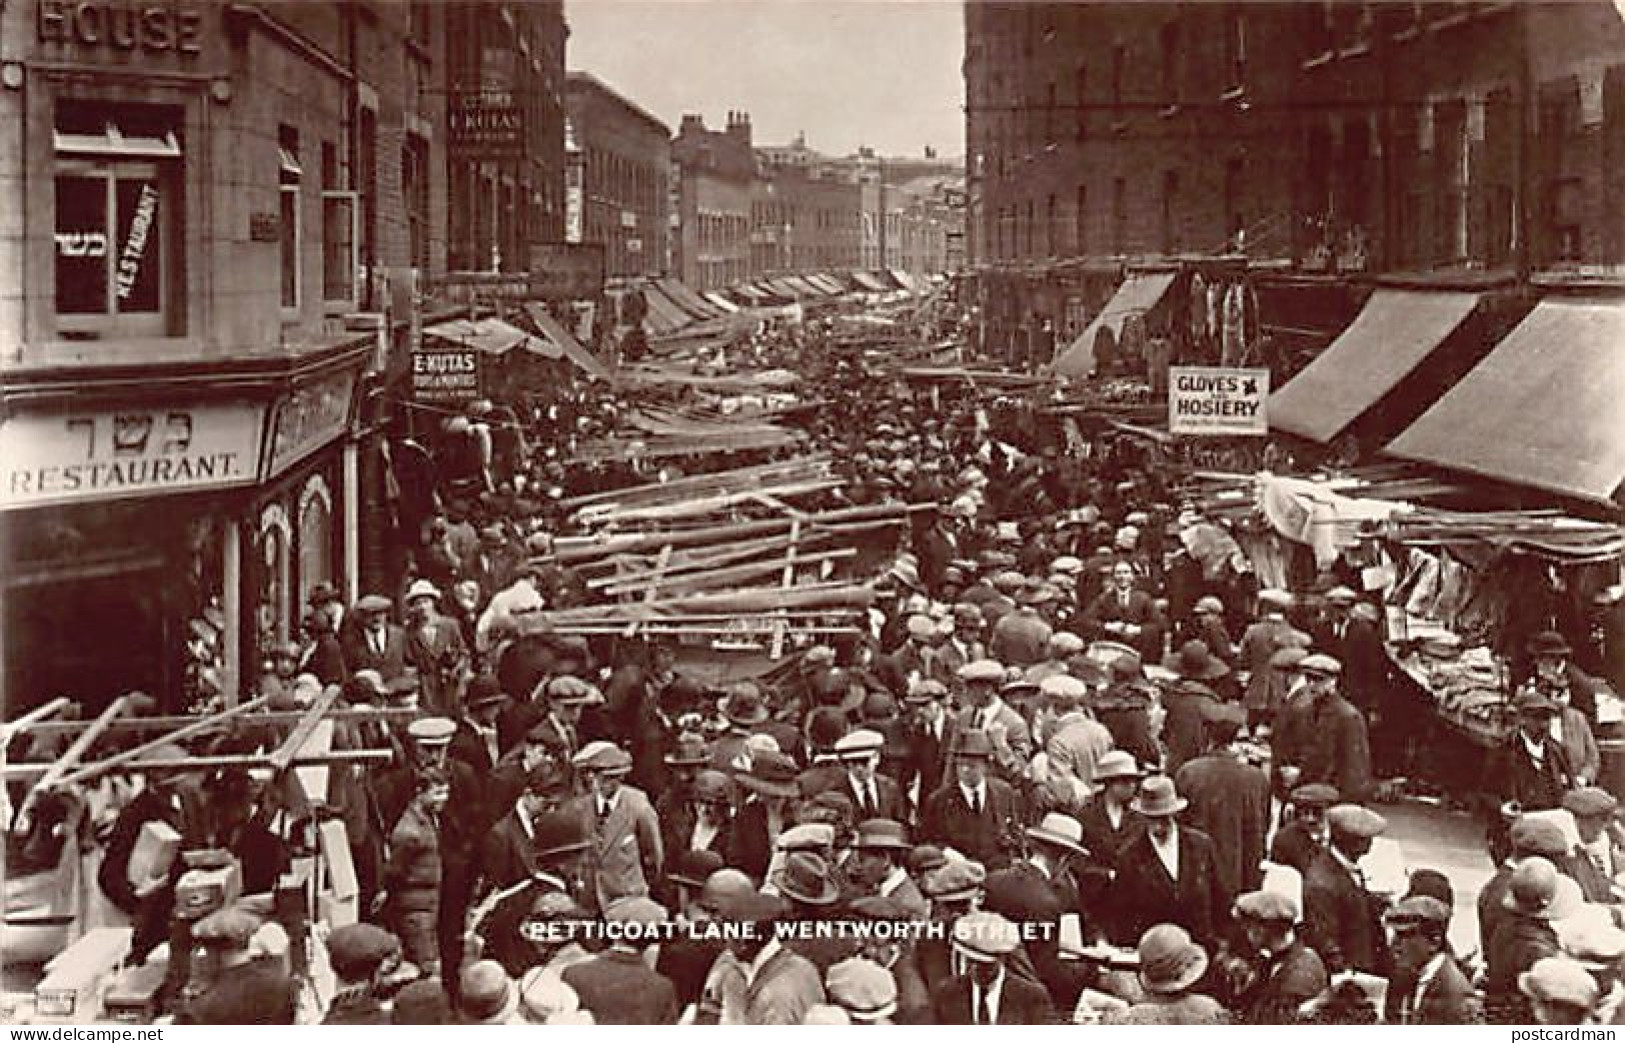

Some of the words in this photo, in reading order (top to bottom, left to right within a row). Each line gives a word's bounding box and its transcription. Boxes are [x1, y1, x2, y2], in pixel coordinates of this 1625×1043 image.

[36, 0, 201, 54] HOUSE
[1178, 375, 1238, 392] GLOVES
[1178, 399, 1260, 416] HOSIERY
[65, 411, 193, 459] כשר
